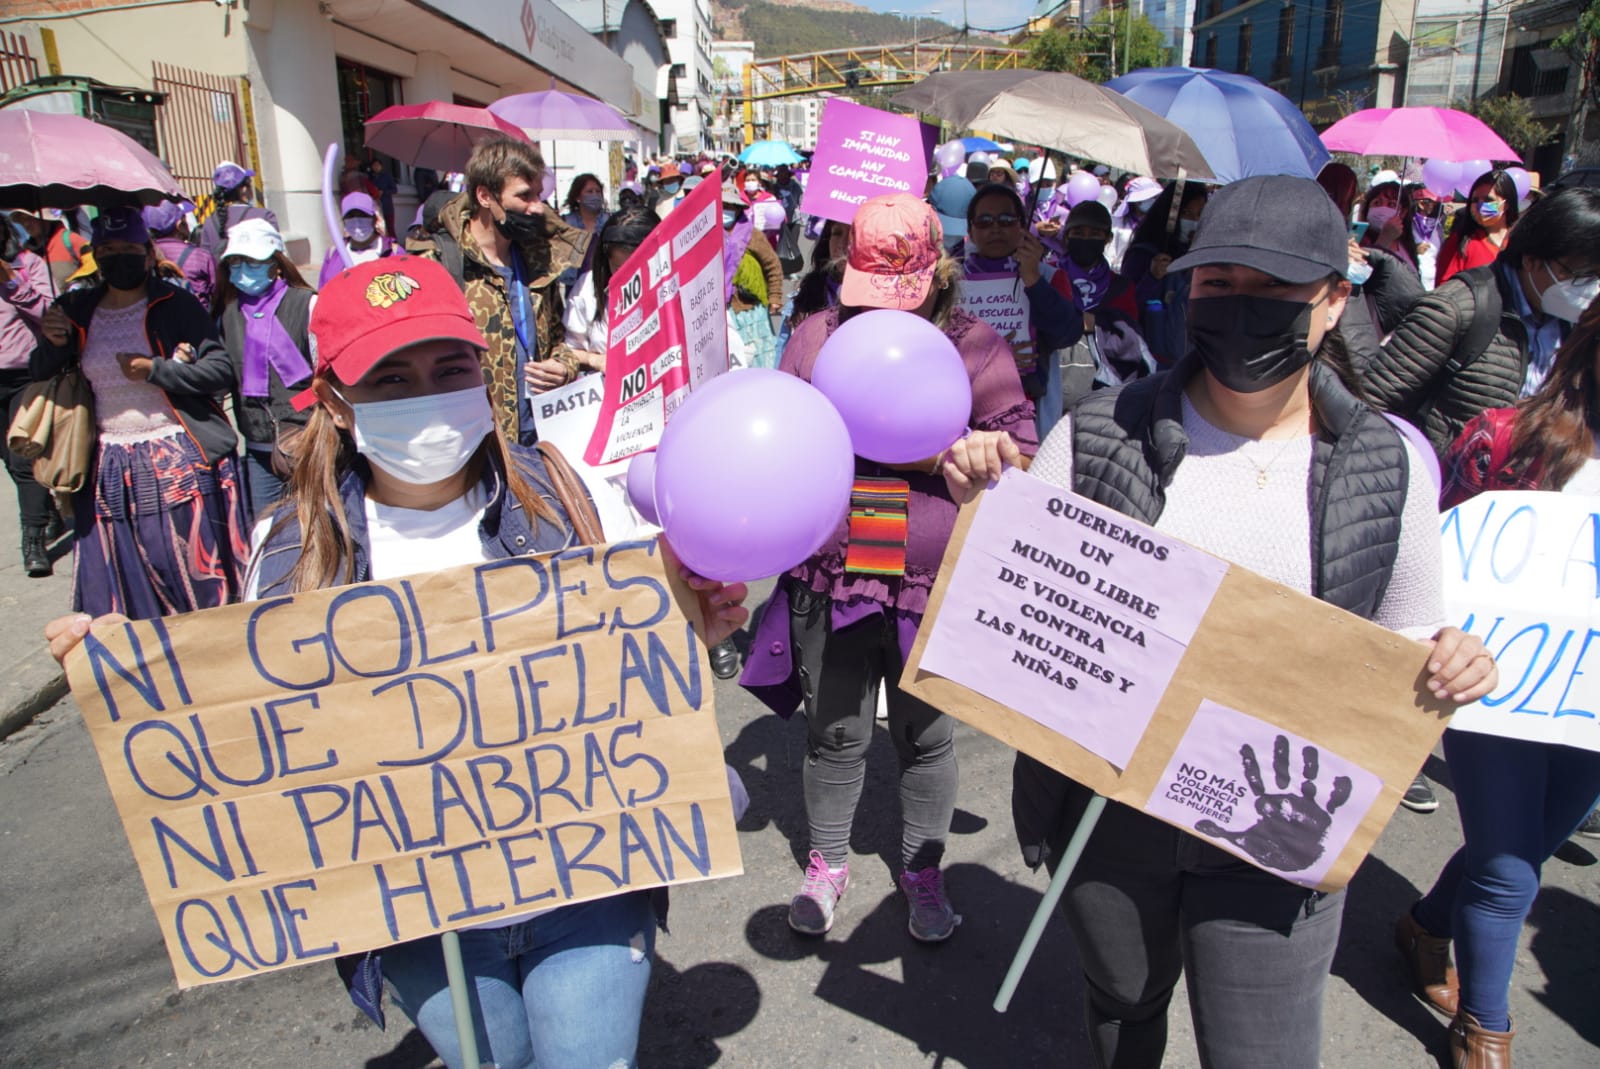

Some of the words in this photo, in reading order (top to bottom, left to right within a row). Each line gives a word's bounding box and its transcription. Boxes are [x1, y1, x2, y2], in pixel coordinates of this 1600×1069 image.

[842, 138, 911, 163] IMPUNIDAD
[860, 130, 876, 141] SI
[876, 134, 901, 147] HAY
[828, 165, 910, 191] COMPLICIDAD
[861, 160, 886, 172] HAY
[623, 273, 641, 310] NO
[679, 215, 708, 248] VIOLENCIA
[690, 289, 707, 311] BASTA
[707, 279, 715, 294] DE
[970, 296, 983, 304] LA
[692, 311, 709, 332] TODAS
[710, 298, 718, 317] LAS
[979, 308, 1024, 317] ESCUELA
[694, 329, 714, 355] FORMAS
[622, 367, 645, 402] NO
[696, 364, 703, 379] DE
[541, 388, 602, 419] BASTA
[616, 422, 653, 443] VIOLENCIA
[621, 415, 629, 427] LA
[1046, 498, 1169, 561] QUEREMOS
[1441, 499, 1538, 584] NO
[1079, 541, 1114, 566] UN
[1011, 539, 1091, 585] MUNDO
[1093, 578, 1160, 619] LIBRE
[998, 567, 1028, 590] DE
[1033, 581, 1146, 647] VIOLENCIA
[83, 617, 192, 722] NI
[247, 537, 672, 691] GOLPES
[1020, 604, 1105, 653] CONTRA
[975, 609, 1015, 636] LAS
[1018, 629, 1115, 684] MUJERES
[1119, 677, 1135, 693] Y
[1011, 650, 1078, 690] NIÑAS
[123, 692, 338, 800] QUE
[363, 622, 702, 767] DUELAN
[1176, 773, 1238, 806] VIOLENCIA
[1180, 763, 1207, 781] NO
[1209, 775, 1247, 797] MÁS
[151, 801, 267, 888] NI
[283, 721, 669, 868] PALABRAS
[1165, 792, 1185, 804] LAS
[1187, 801, 1231, 824] MUJERES
[1170, 783, 1232, 816] CONTRA
[175, 879, 339, 977] QUE
[375, 803, 712, 940] HIERAN
